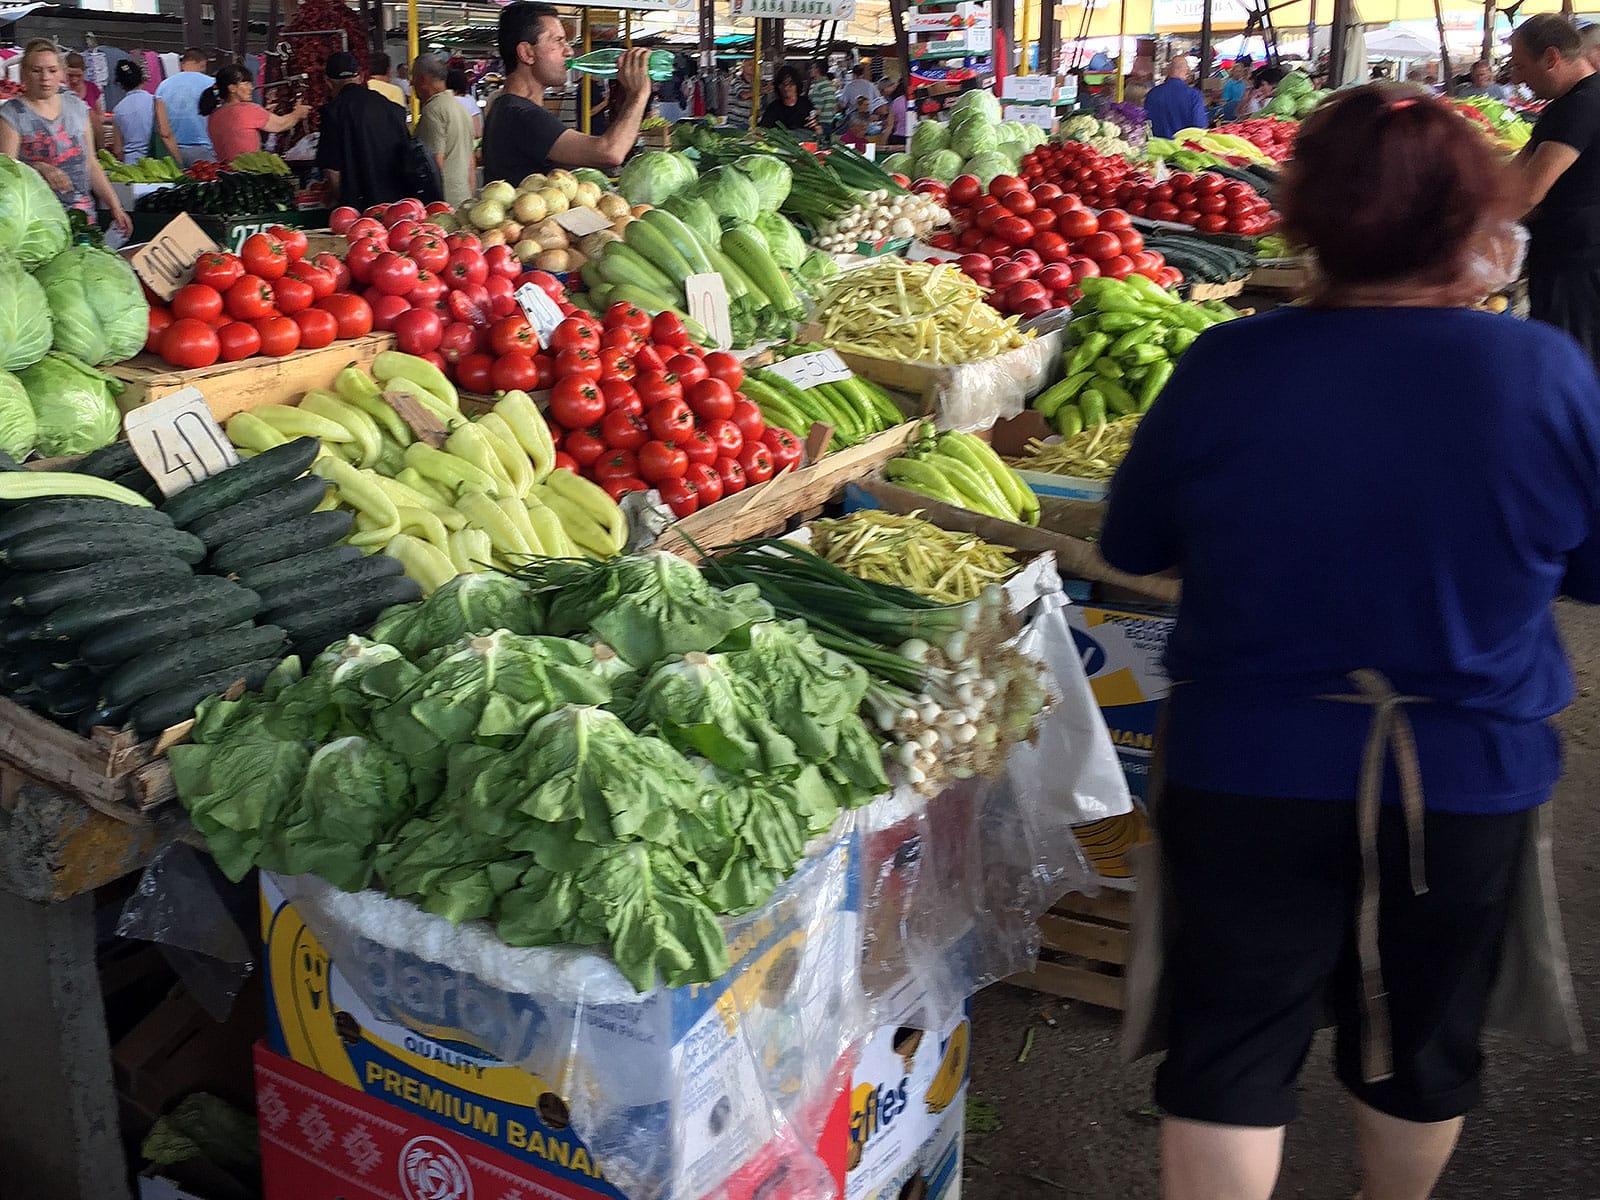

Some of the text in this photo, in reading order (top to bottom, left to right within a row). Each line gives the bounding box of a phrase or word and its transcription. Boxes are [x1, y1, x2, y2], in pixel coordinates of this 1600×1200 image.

[152, 412, 232, 484] 40
[403, 1036, 486, 1079] QUALITY
[366, 1061, 498, 1137] PREMIUM
